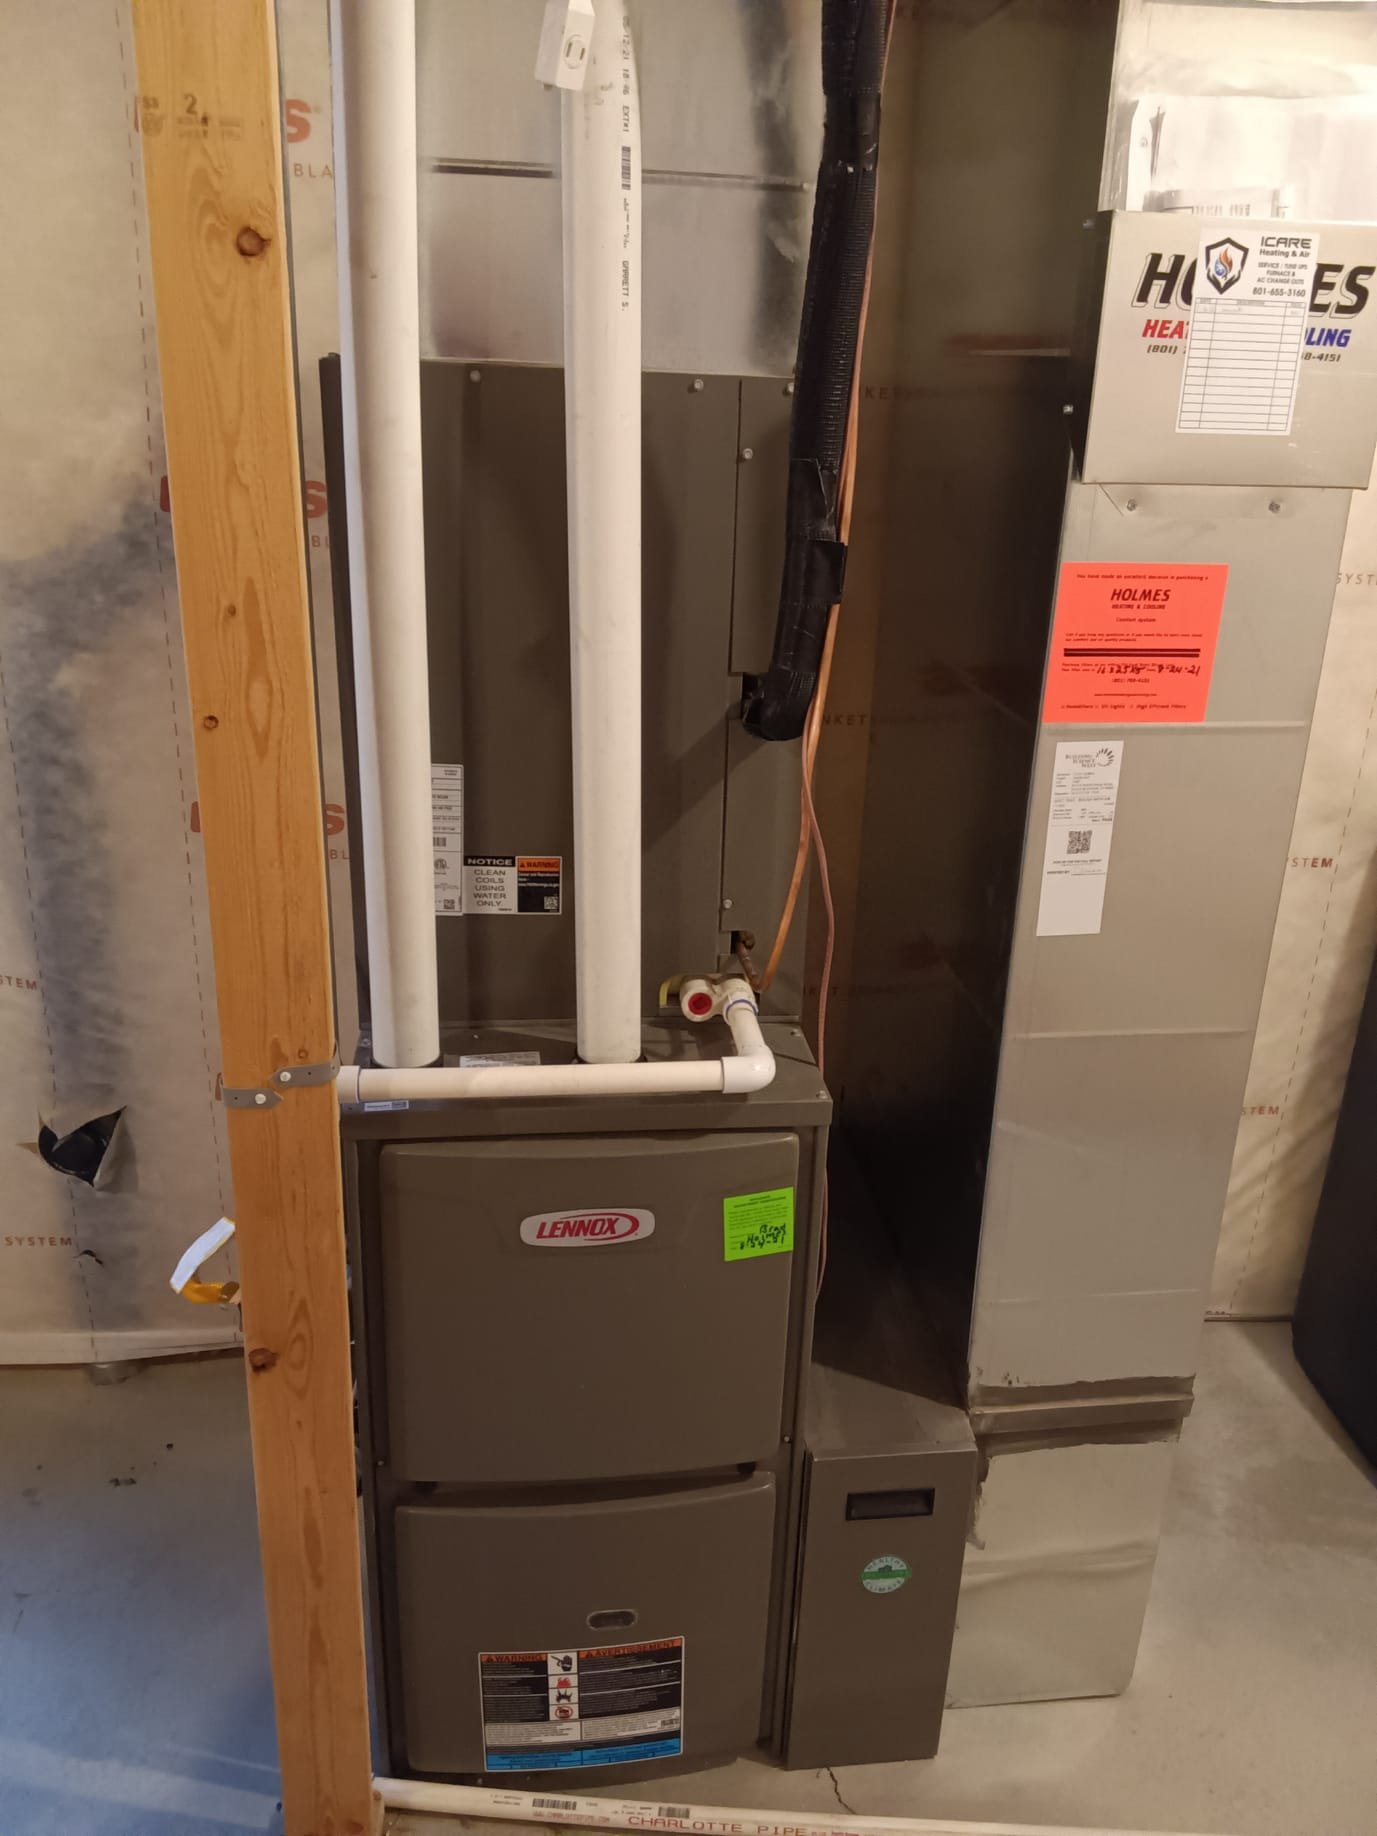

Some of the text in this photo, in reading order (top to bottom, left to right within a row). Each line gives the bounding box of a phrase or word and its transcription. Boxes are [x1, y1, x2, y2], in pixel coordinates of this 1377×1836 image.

[1260, 235, 1312, 249] ICARE
[1259, 249, 1289, 258] Heating
[1252, 286, 1306, 298] 801-655-3160
[1110, 588, 1171, 602] HOLMES
[467, 857, 513, 867] NOTICE
[475, 876, 505, 884] COILS
[474, 884, 506, 892] USING
[473, 892, 507, 900] WATER
[535, 1217, 620, 1240] LENNOX
[4, 1236, 72, 1247] SYSTEM
[627, 1815, 808, 1836] CHARLOTTE PIPE
